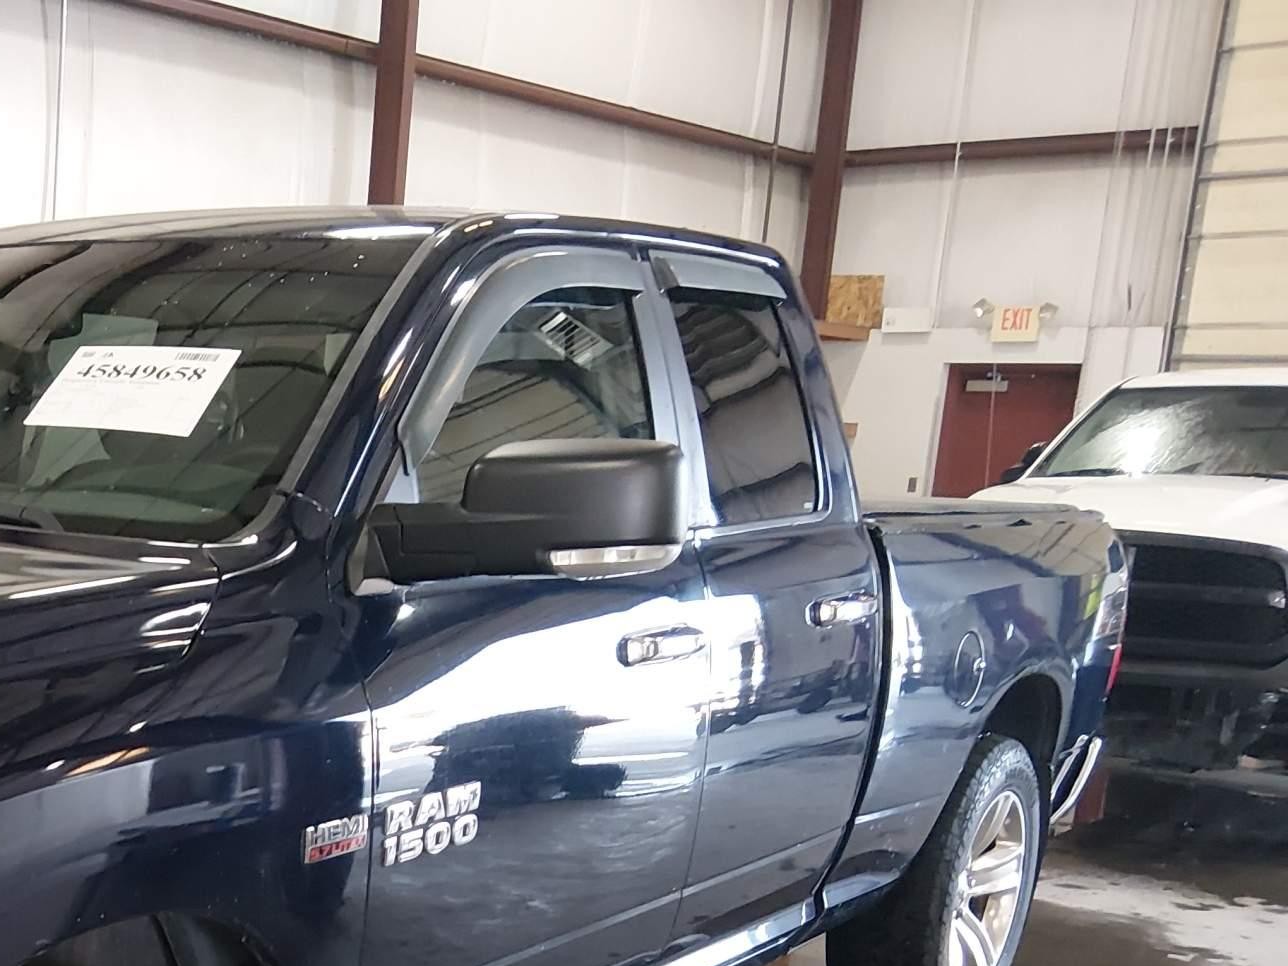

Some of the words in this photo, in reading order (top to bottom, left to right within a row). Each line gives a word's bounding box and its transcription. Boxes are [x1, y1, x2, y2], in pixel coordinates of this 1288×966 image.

[1001, 308, 1033, 331] EXIT
[77, 363, 207, 382] 45849658
[385, 781, 481, 835] RAM
[305, 814, 368, 847] HEMI
[384, 813, 478, 866] 1500
